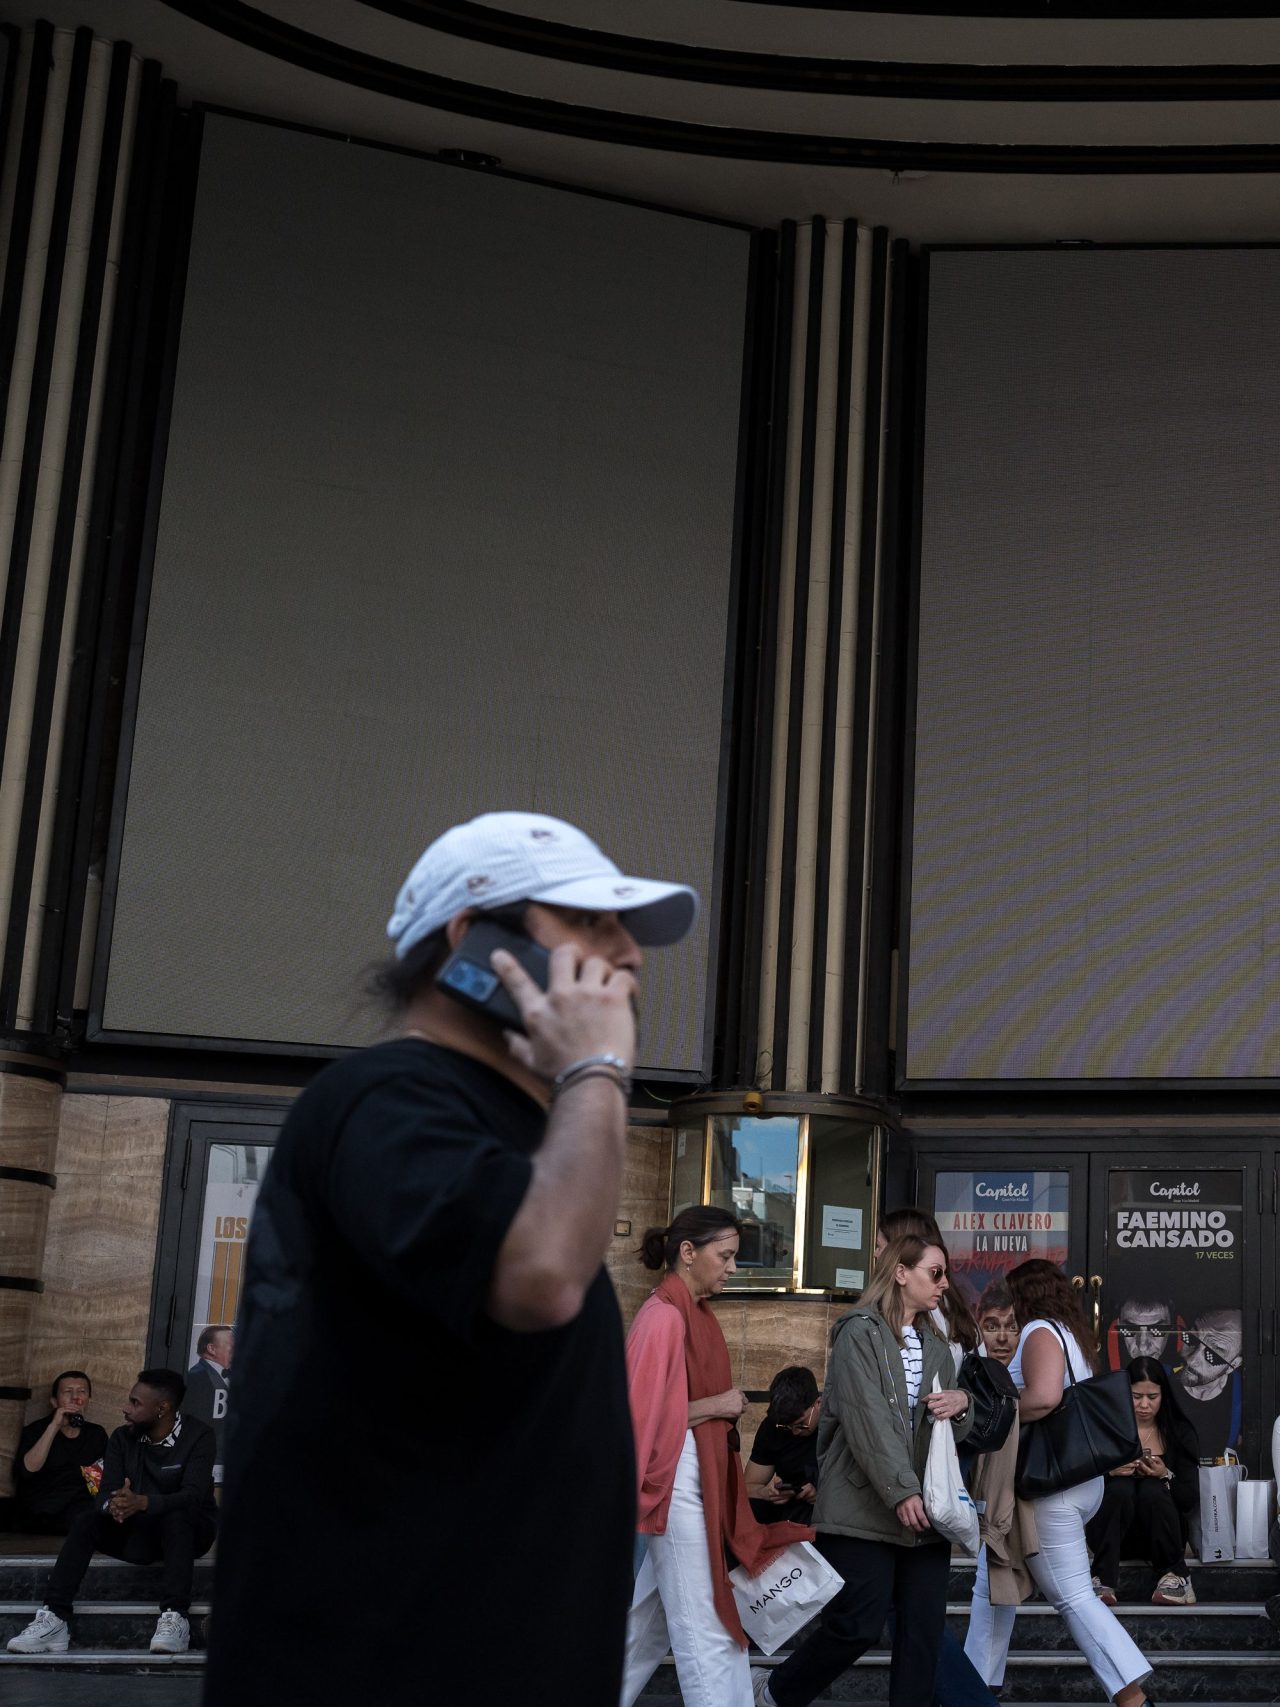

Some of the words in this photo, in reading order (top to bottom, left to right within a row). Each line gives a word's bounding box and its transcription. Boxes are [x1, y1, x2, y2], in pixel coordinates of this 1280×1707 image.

[975, 1182, 1029, 1200] Capitol
[1149, 1182, 1201, 1199] Capitol
[993, 1213, 1053, 1230] CLAVERO
[1117, 1211, 1227, 1229] FAEMINO
[976, 1235, 988, 1251] LA
[994, 1235, 1028, 1251] NUEVA
[1116, 1229, 1235, 1248] CANSADO
[1195, 1251, 1204, 1259] 17
[1206, 1251, 1234, 1259] VECES
[750, 1568, 802, 1614] MANGO
